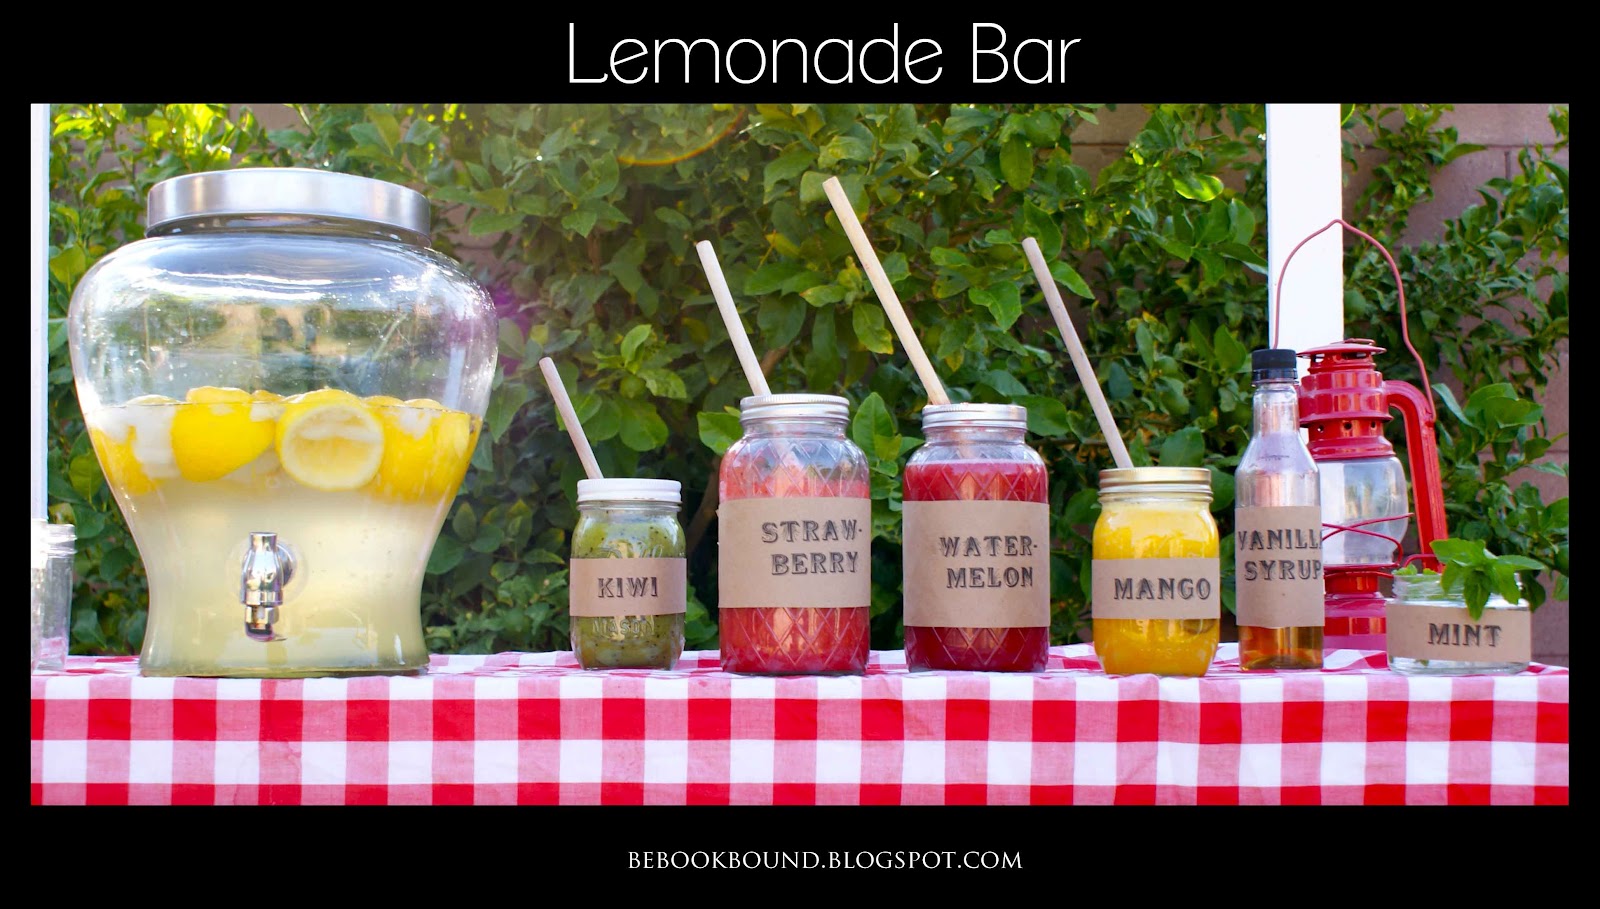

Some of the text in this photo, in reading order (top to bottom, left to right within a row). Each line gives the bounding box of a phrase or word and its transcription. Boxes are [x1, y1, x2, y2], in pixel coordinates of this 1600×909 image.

[1238, 528, 1322, 550] VANILL
[771, 551, 858, 575] BERRY
[1244, 559, 1321, 581] SYRUP
[597, 576, 658, 598] KIWI
[946, 566, 1033, 588] MELON
[1113, 577, 1211, 601] MANGO
[1427, 622, 1502, 647] MINT
